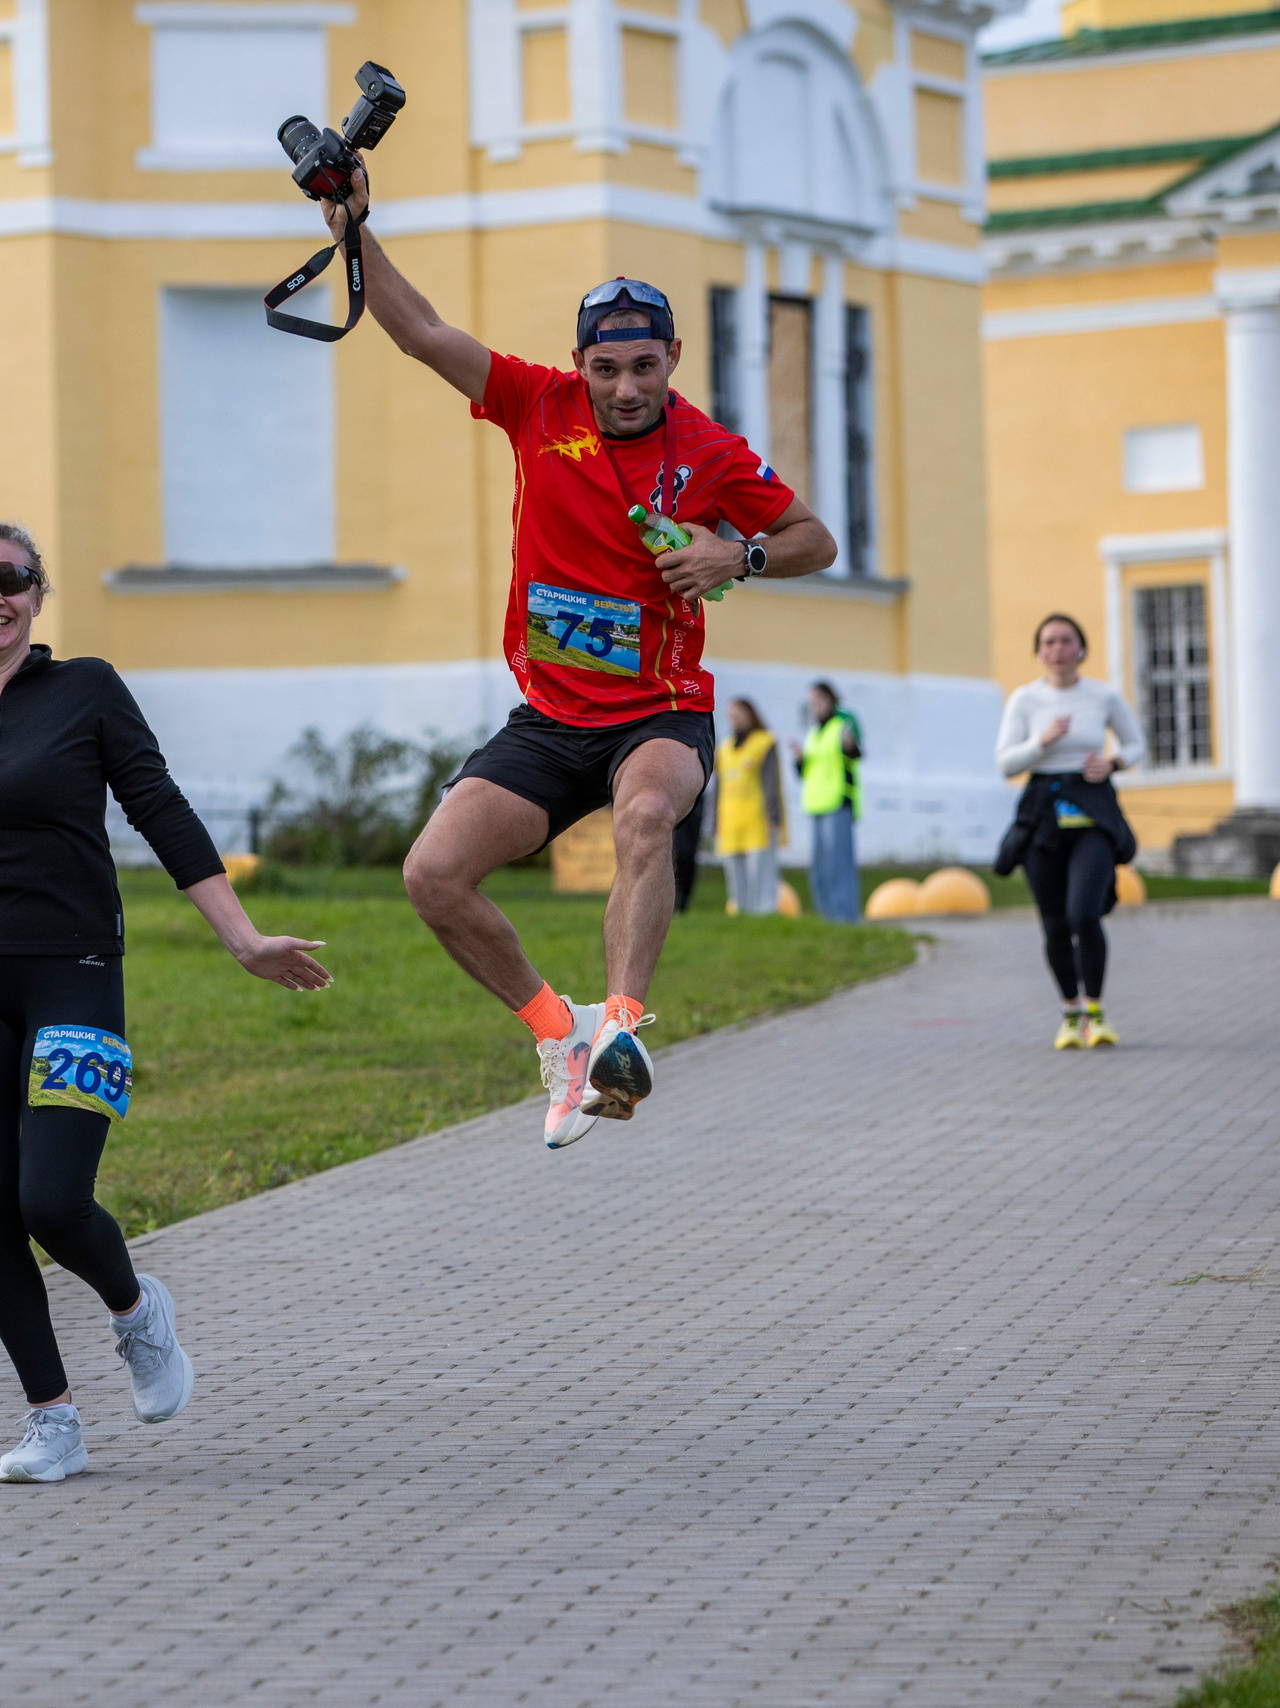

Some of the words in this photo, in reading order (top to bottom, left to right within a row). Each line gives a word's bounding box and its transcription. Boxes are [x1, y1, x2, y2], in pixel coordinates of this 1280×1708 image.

[286, 274, 305, 291] EOS
[351, 258, 361, 291] Canon
[536, 588, 587, 605] СТАРИЦКИЕ
[594, 599, 633, 613] ВЕРСТЫ
[557, 610, 615, 658] 75
[79, 959, 106, 967] DEMIX
[43, 1030, 96, 1041] СТАРИЦКИЕ
[40, 1047, 126, 1102] 269
